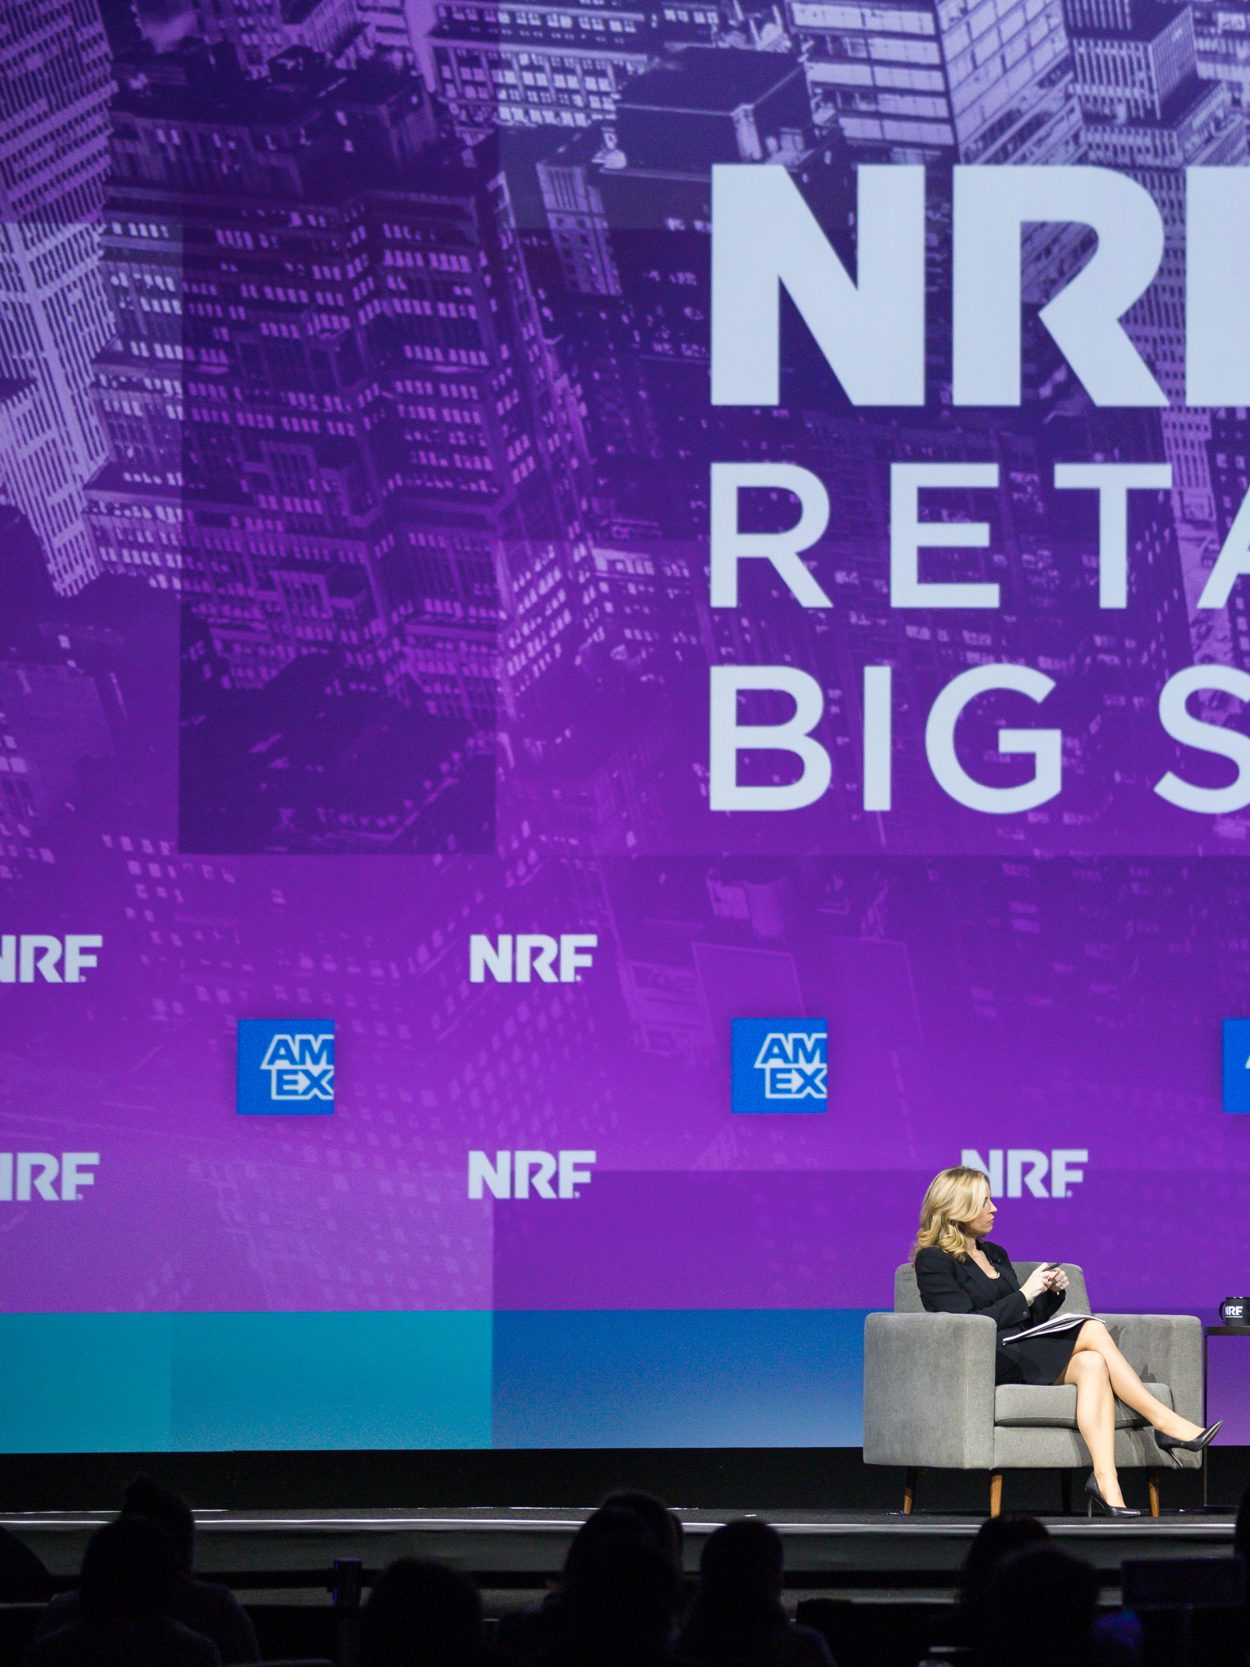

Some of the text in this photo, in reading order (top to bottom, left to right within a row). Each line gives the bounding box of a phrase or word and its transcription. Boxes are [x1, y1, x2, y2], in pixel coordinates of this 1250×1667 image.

[709, 662, 1062, 815] BIG
[469, 934, 598, 983] NRF
[0, 1152, 100, 1201] RF
[468, 1150, 597, 1200] NRF
